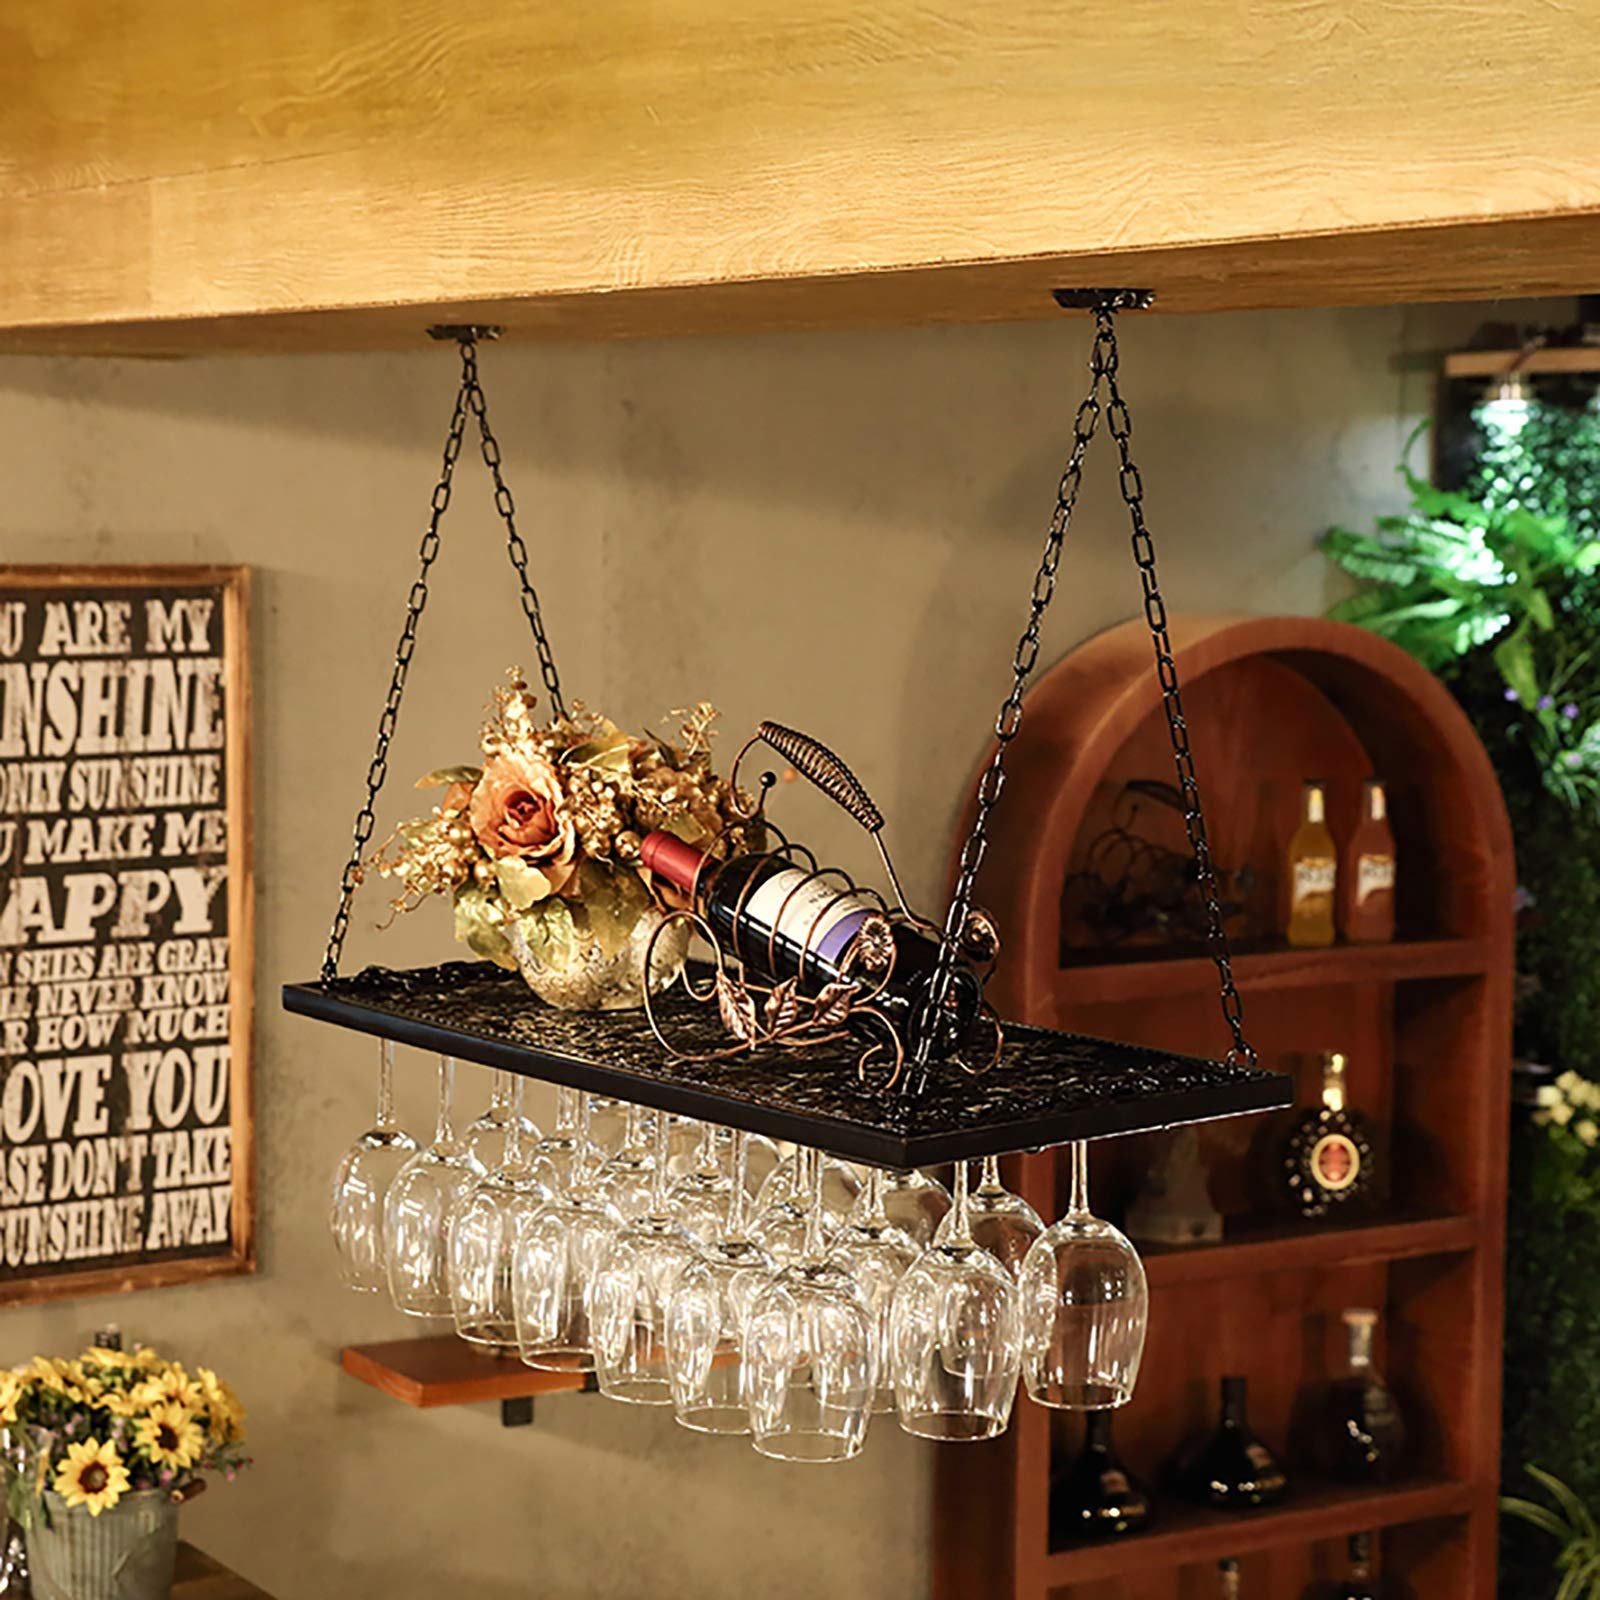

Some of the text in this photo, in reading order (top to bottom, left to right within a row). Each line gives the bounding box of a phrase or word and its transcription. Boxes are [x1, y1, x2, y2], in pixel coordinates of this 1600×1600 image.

[38, 600, 132, 656] ARE
[145, 598, 214, 653] MY
[69, 754, 221, 812] SUNSHINE
[23, 814, 156, 864] MAKE
[160, 810, 228, 857] ME
[0, 865, 229, 946] APPY
[97, 942, 156, 978] ARE
[158, 937, 229, 974] GRAY
[35, 977, 135, 1018] NEVER
[140, 971, 230, 1010] KNOW
[0, 1005, 230, 1056] R HOW MUCH
[0, 1046, 231, 1144] OVE YOU
[49, 1134, 149, 1201] DON'T
[151, 1126, 232, 1190] TAKE
[0, 1186, 232, 1269] UNSHINE AWAY
